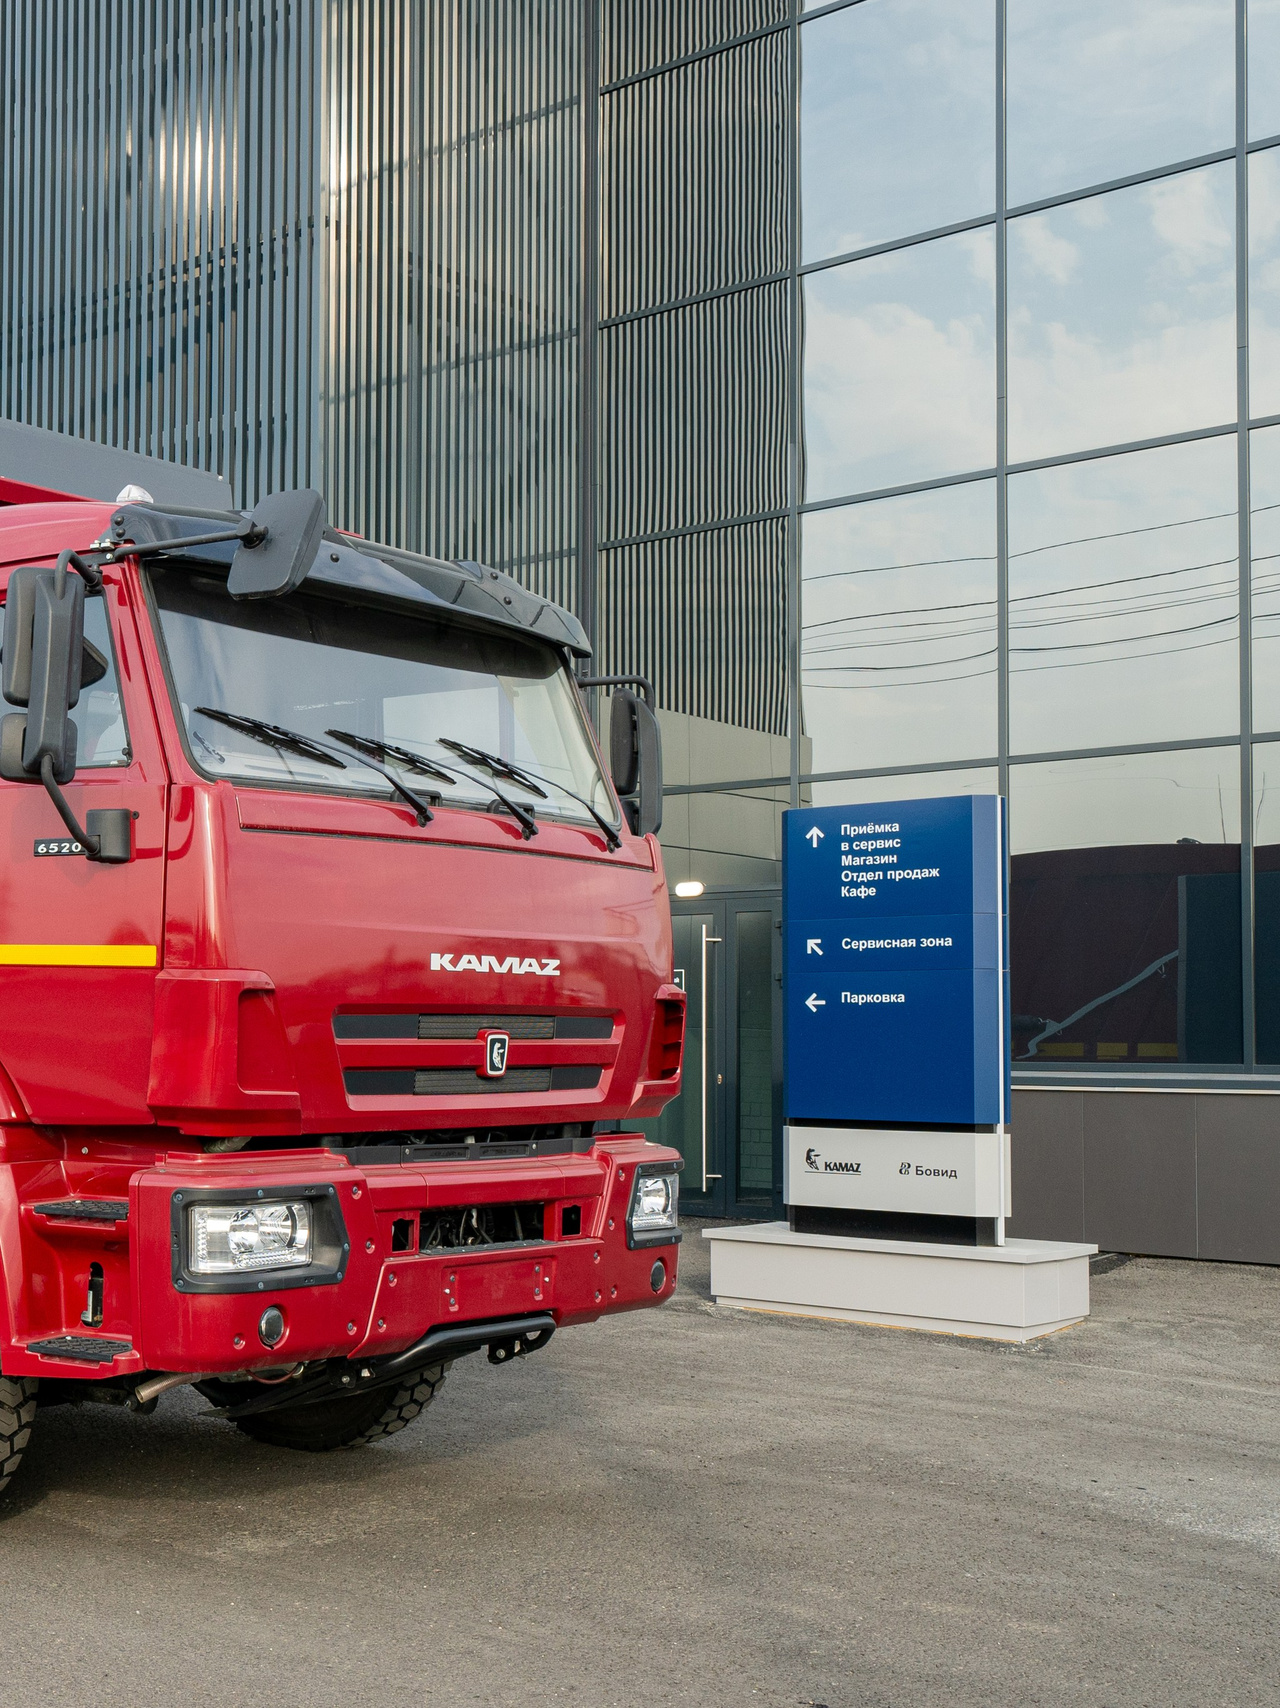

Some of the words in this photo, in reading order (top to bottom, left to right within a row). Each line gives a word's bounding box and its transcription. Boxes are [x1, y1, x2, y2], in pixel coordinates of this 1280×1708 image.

[840, 822, 900, 837] Приёмка
[37, 842, 82, 854] 6520
[840, 841, 850, 851] в
[852, 838, 901, 852] сервис
[841, 854, 898, 867] Магазин
[841, 870, 883, 883] Отдел
[887, 867, 940, 882] продаж
[841, 885, 877, 899] Кафе
[841, 937, 917, 952] Сервисная
[920, 936, 953, 948] зона
[430, 953, 561, 976] KAMAZ
[841, 991, 905, 1006] Парковка
[824, 1161, 862, 1173] KAMAZ
[915, 1165, 958, 1180] Бовид
